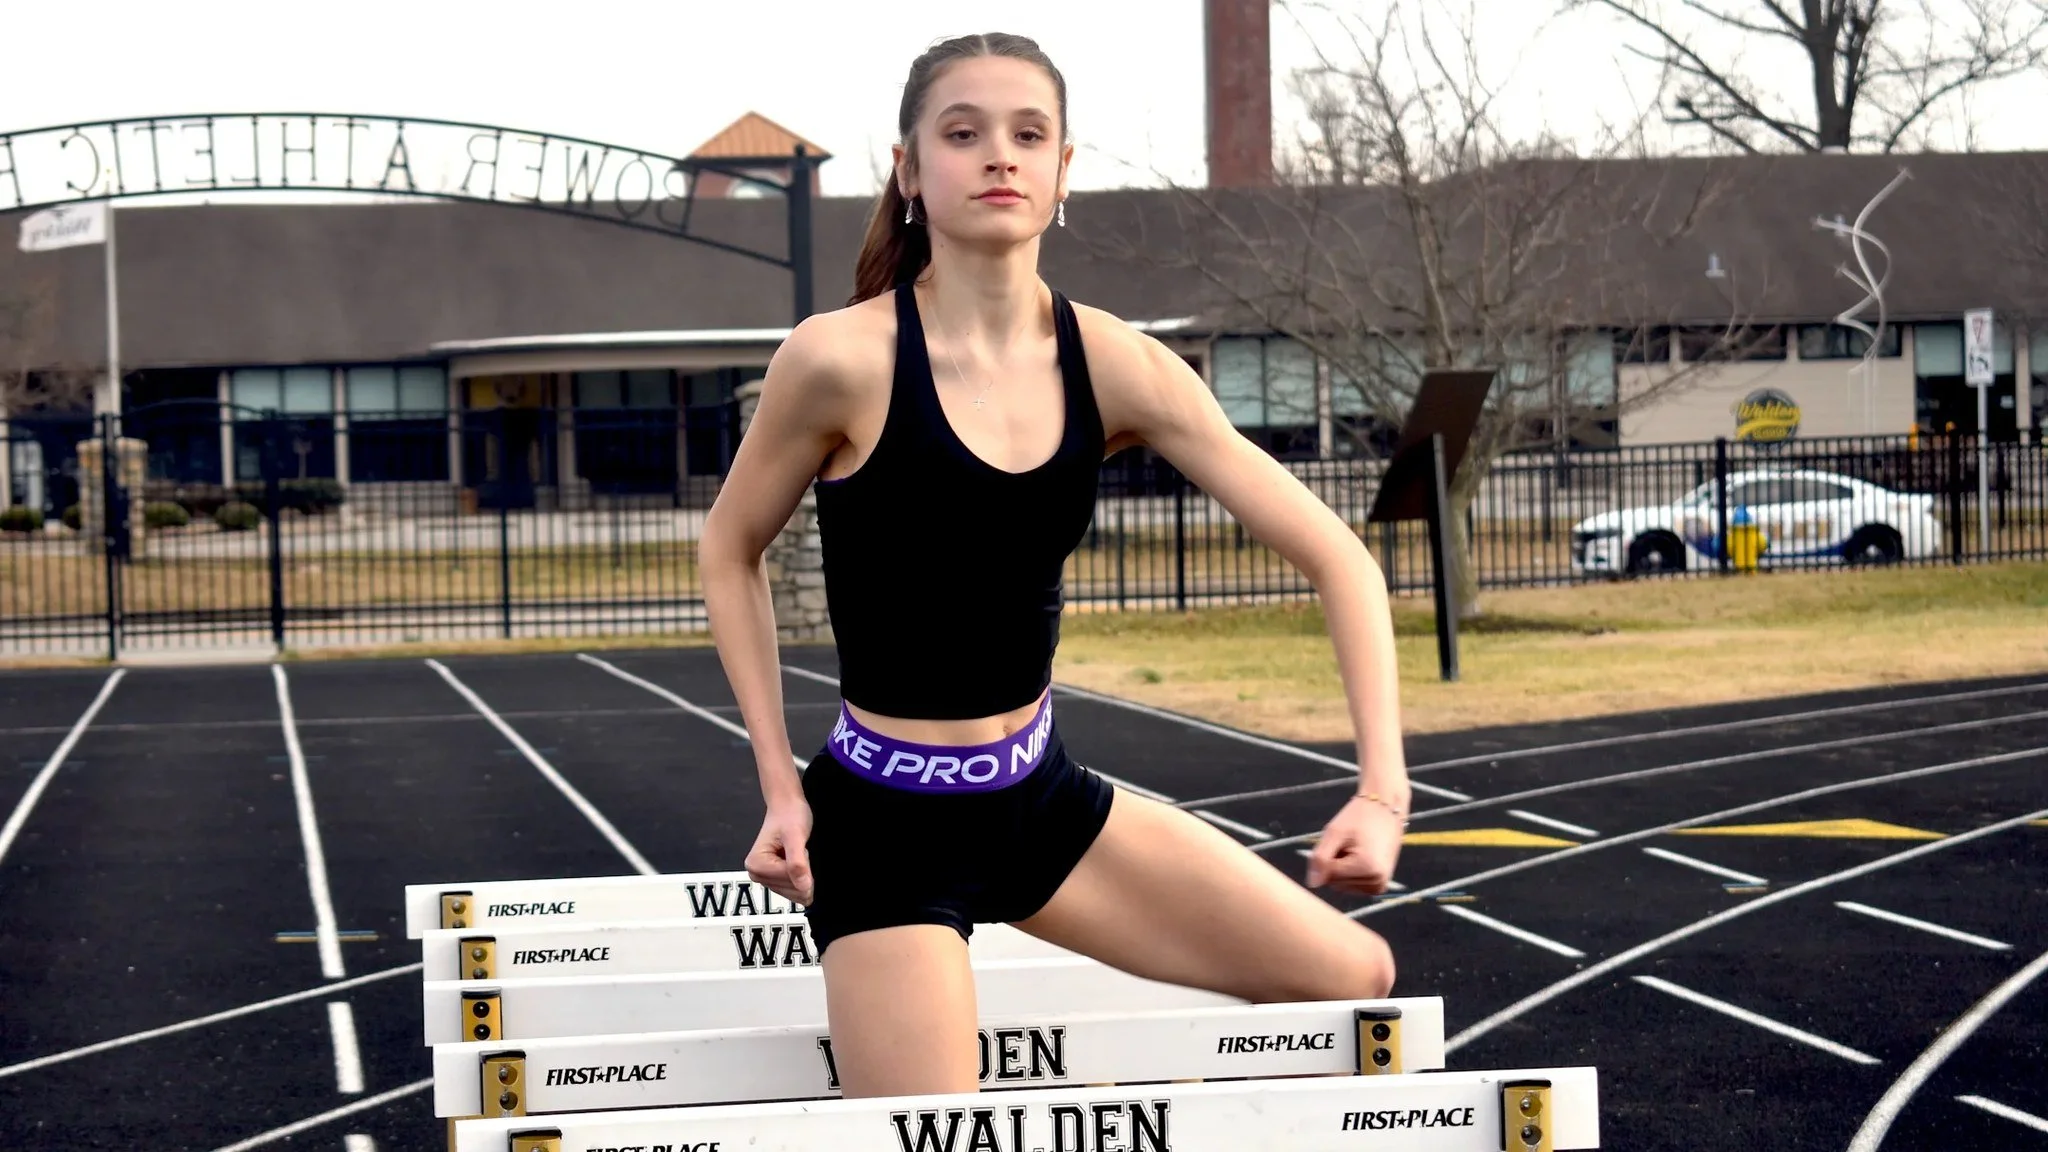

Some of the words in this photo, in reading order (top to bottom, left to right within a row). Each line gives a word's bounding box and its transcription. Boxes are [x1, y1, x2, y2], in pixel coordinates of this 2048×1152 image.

[833, 711, 882, 770] IKE
[881, 750, 999, 784] PRO
[487, 903, 525, 917] FIRST
[530, 901, 576, 916] PLACE
[684, 880, 807, 918] WAL
[512, 949, 556, 965] FIRST
[560, 947, 610, 963] PLACE
[730, 923, 821, 970] WA
[1217, 1035, 1270, 1054] FIRST
[1274, 1032, 1335, 1052] PLACE
[545, 1066, 600, 1086] FIRST
[604, 1063, 667, 1083] PLACE
[890, 1099, 1172, 1152] WALDEN
[1341, 1110, 1402, 1131] FIRST
[1406, 1107, 1475, 1128] PLACE
